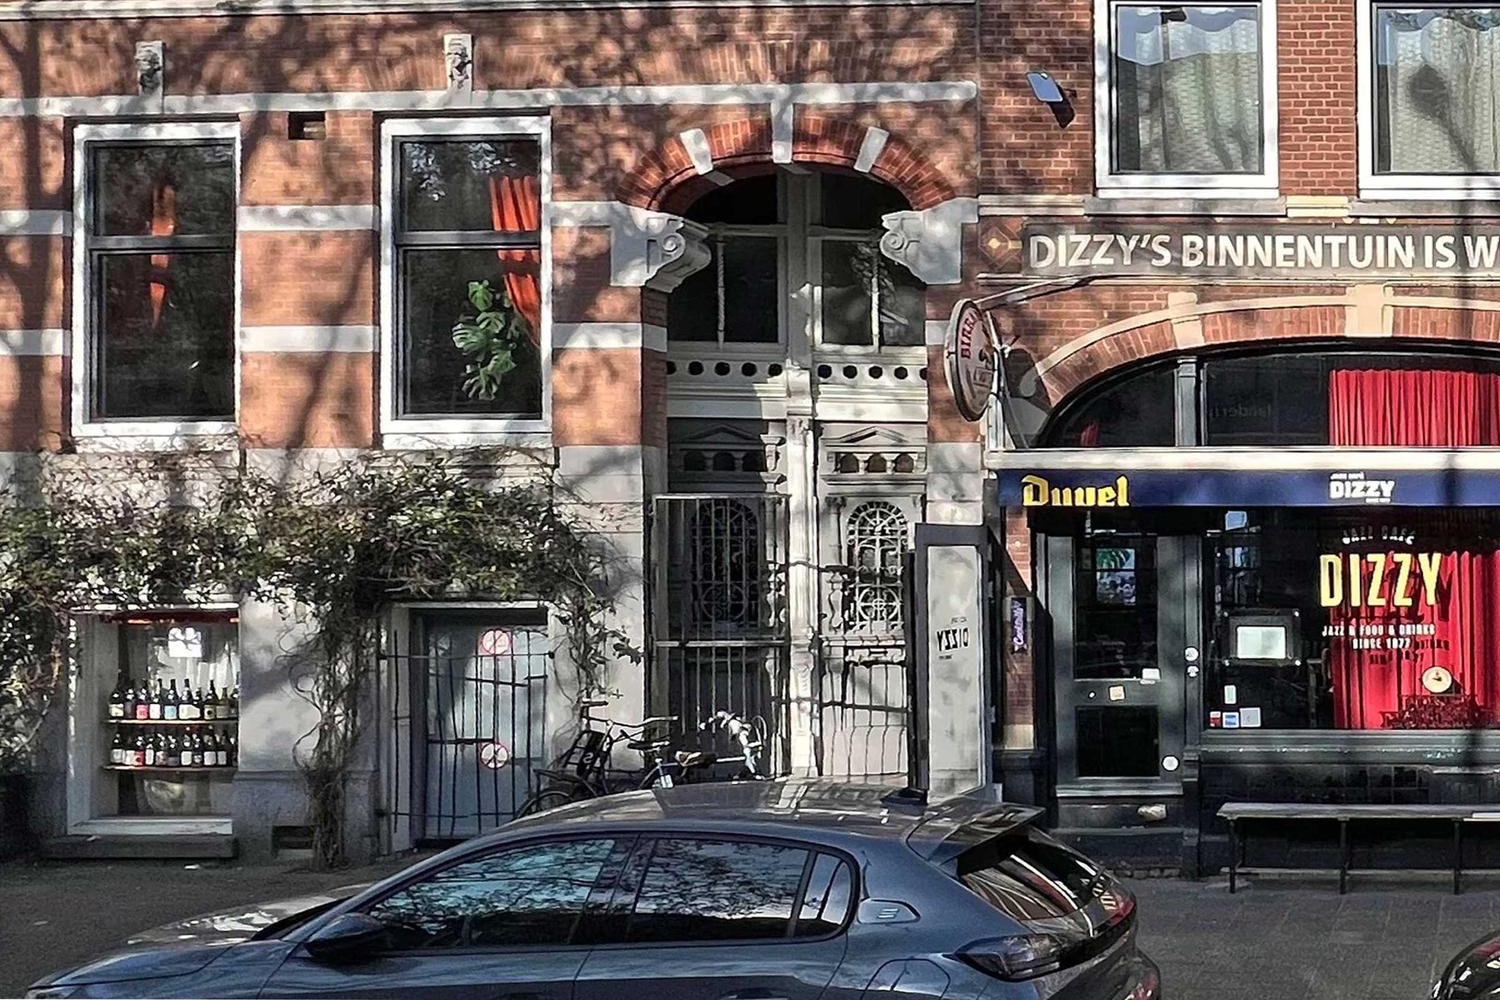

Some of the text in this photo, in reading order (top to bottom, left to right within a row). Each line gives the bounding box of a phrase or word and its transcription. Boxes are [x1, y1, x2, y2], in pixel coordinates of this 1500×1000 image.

[1030, 234, 1171, 268] DIZZY'S
[1181, 234, 1415, 268] BINNENTUIN
[1424, 235, 1455, 268] IS
[1021, 475, 1129, 506] Duvel
[1329, 480, 1395, 499] DIZZY
[1320, 552, 1441, 607] DIZZY
